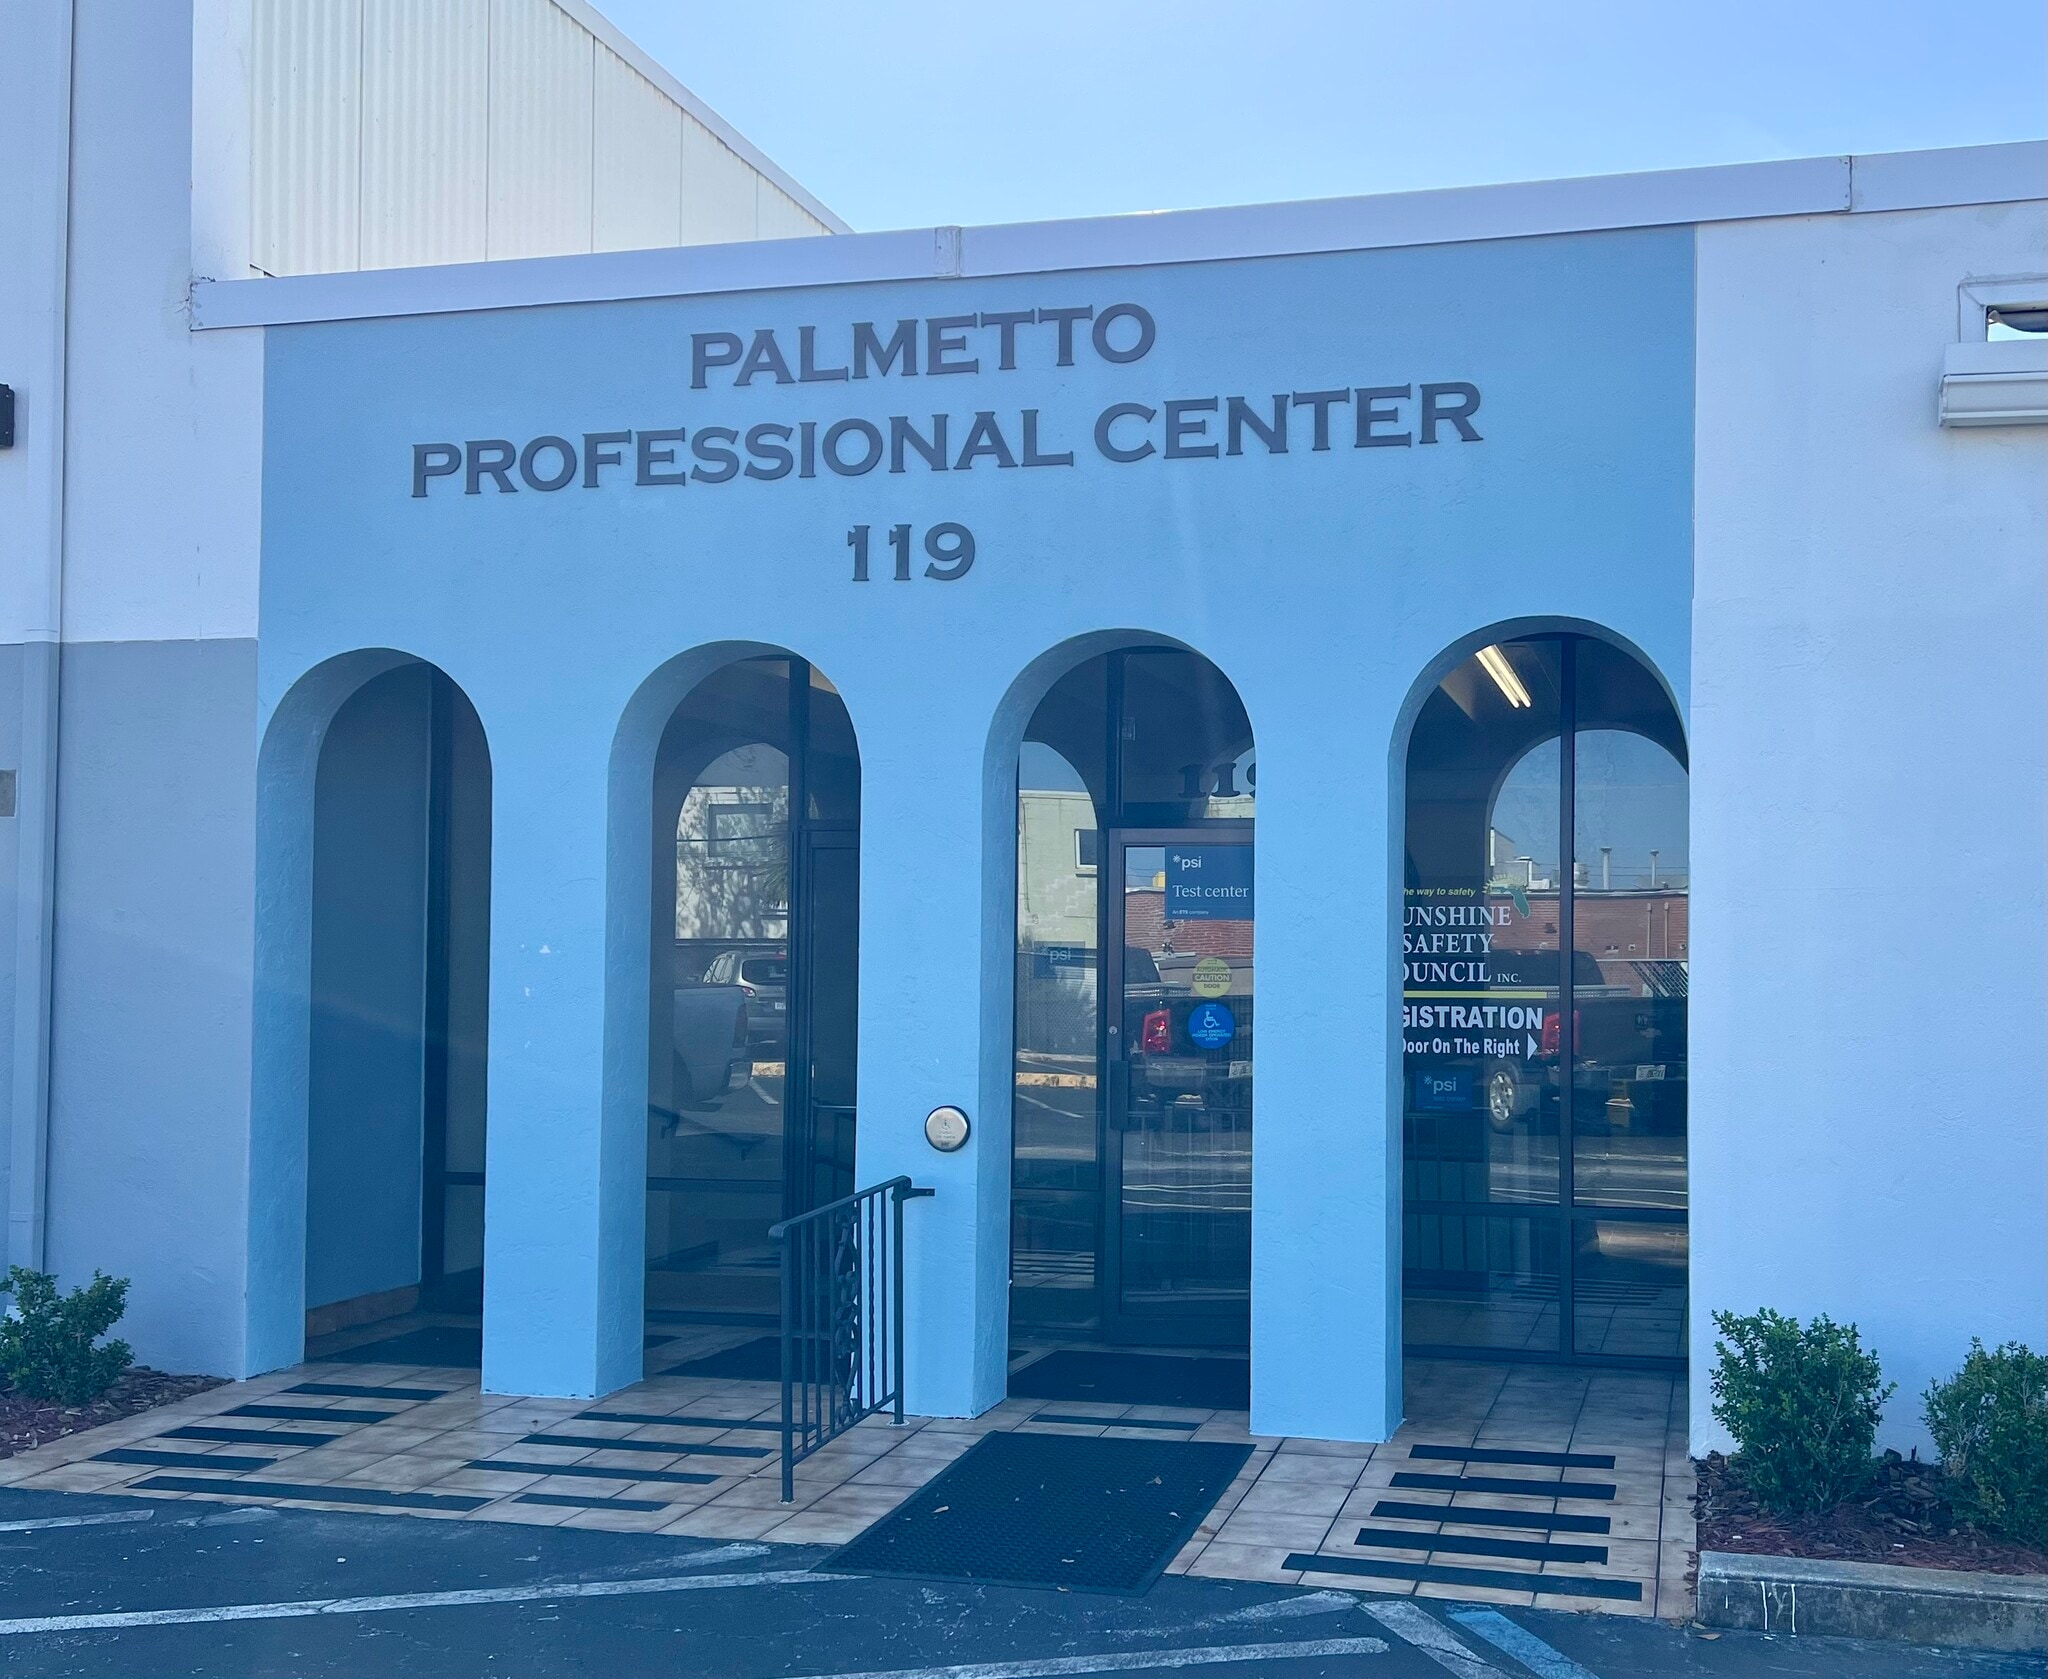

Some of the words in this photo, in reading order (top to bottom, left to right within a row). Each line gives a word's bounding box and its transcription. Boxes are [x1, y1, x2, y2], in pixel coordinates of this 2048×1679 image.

[690, 303, 1156, 389] PALMETTO
[412, 408, 1073, 498] PROFESSIONAL
[1094, 381, 1483, 465] CENTER
[847, 521, 975, 582] 119
[1182, 855, 1202, 871] psi
[1172, 885, 1201, 898] Test
[1204, 886, 1249, 898] center
[1416, 889, 1434, 898] way
[1436, 888, 1446, 896] to
[1448, 887, 1476, 898] safety
[1403, 933, 1495, 954] SAFETY
[1049, 947, 1071, 964] psi
[1497, 973, 1522, 983] INC.
[1432, 1038, 1451, 1054] On
[1454, 1038, 1480, 1054] The
[1483, 1038, 1520, 1059] Right
[1433, 1077, 1457, 1095] psi
